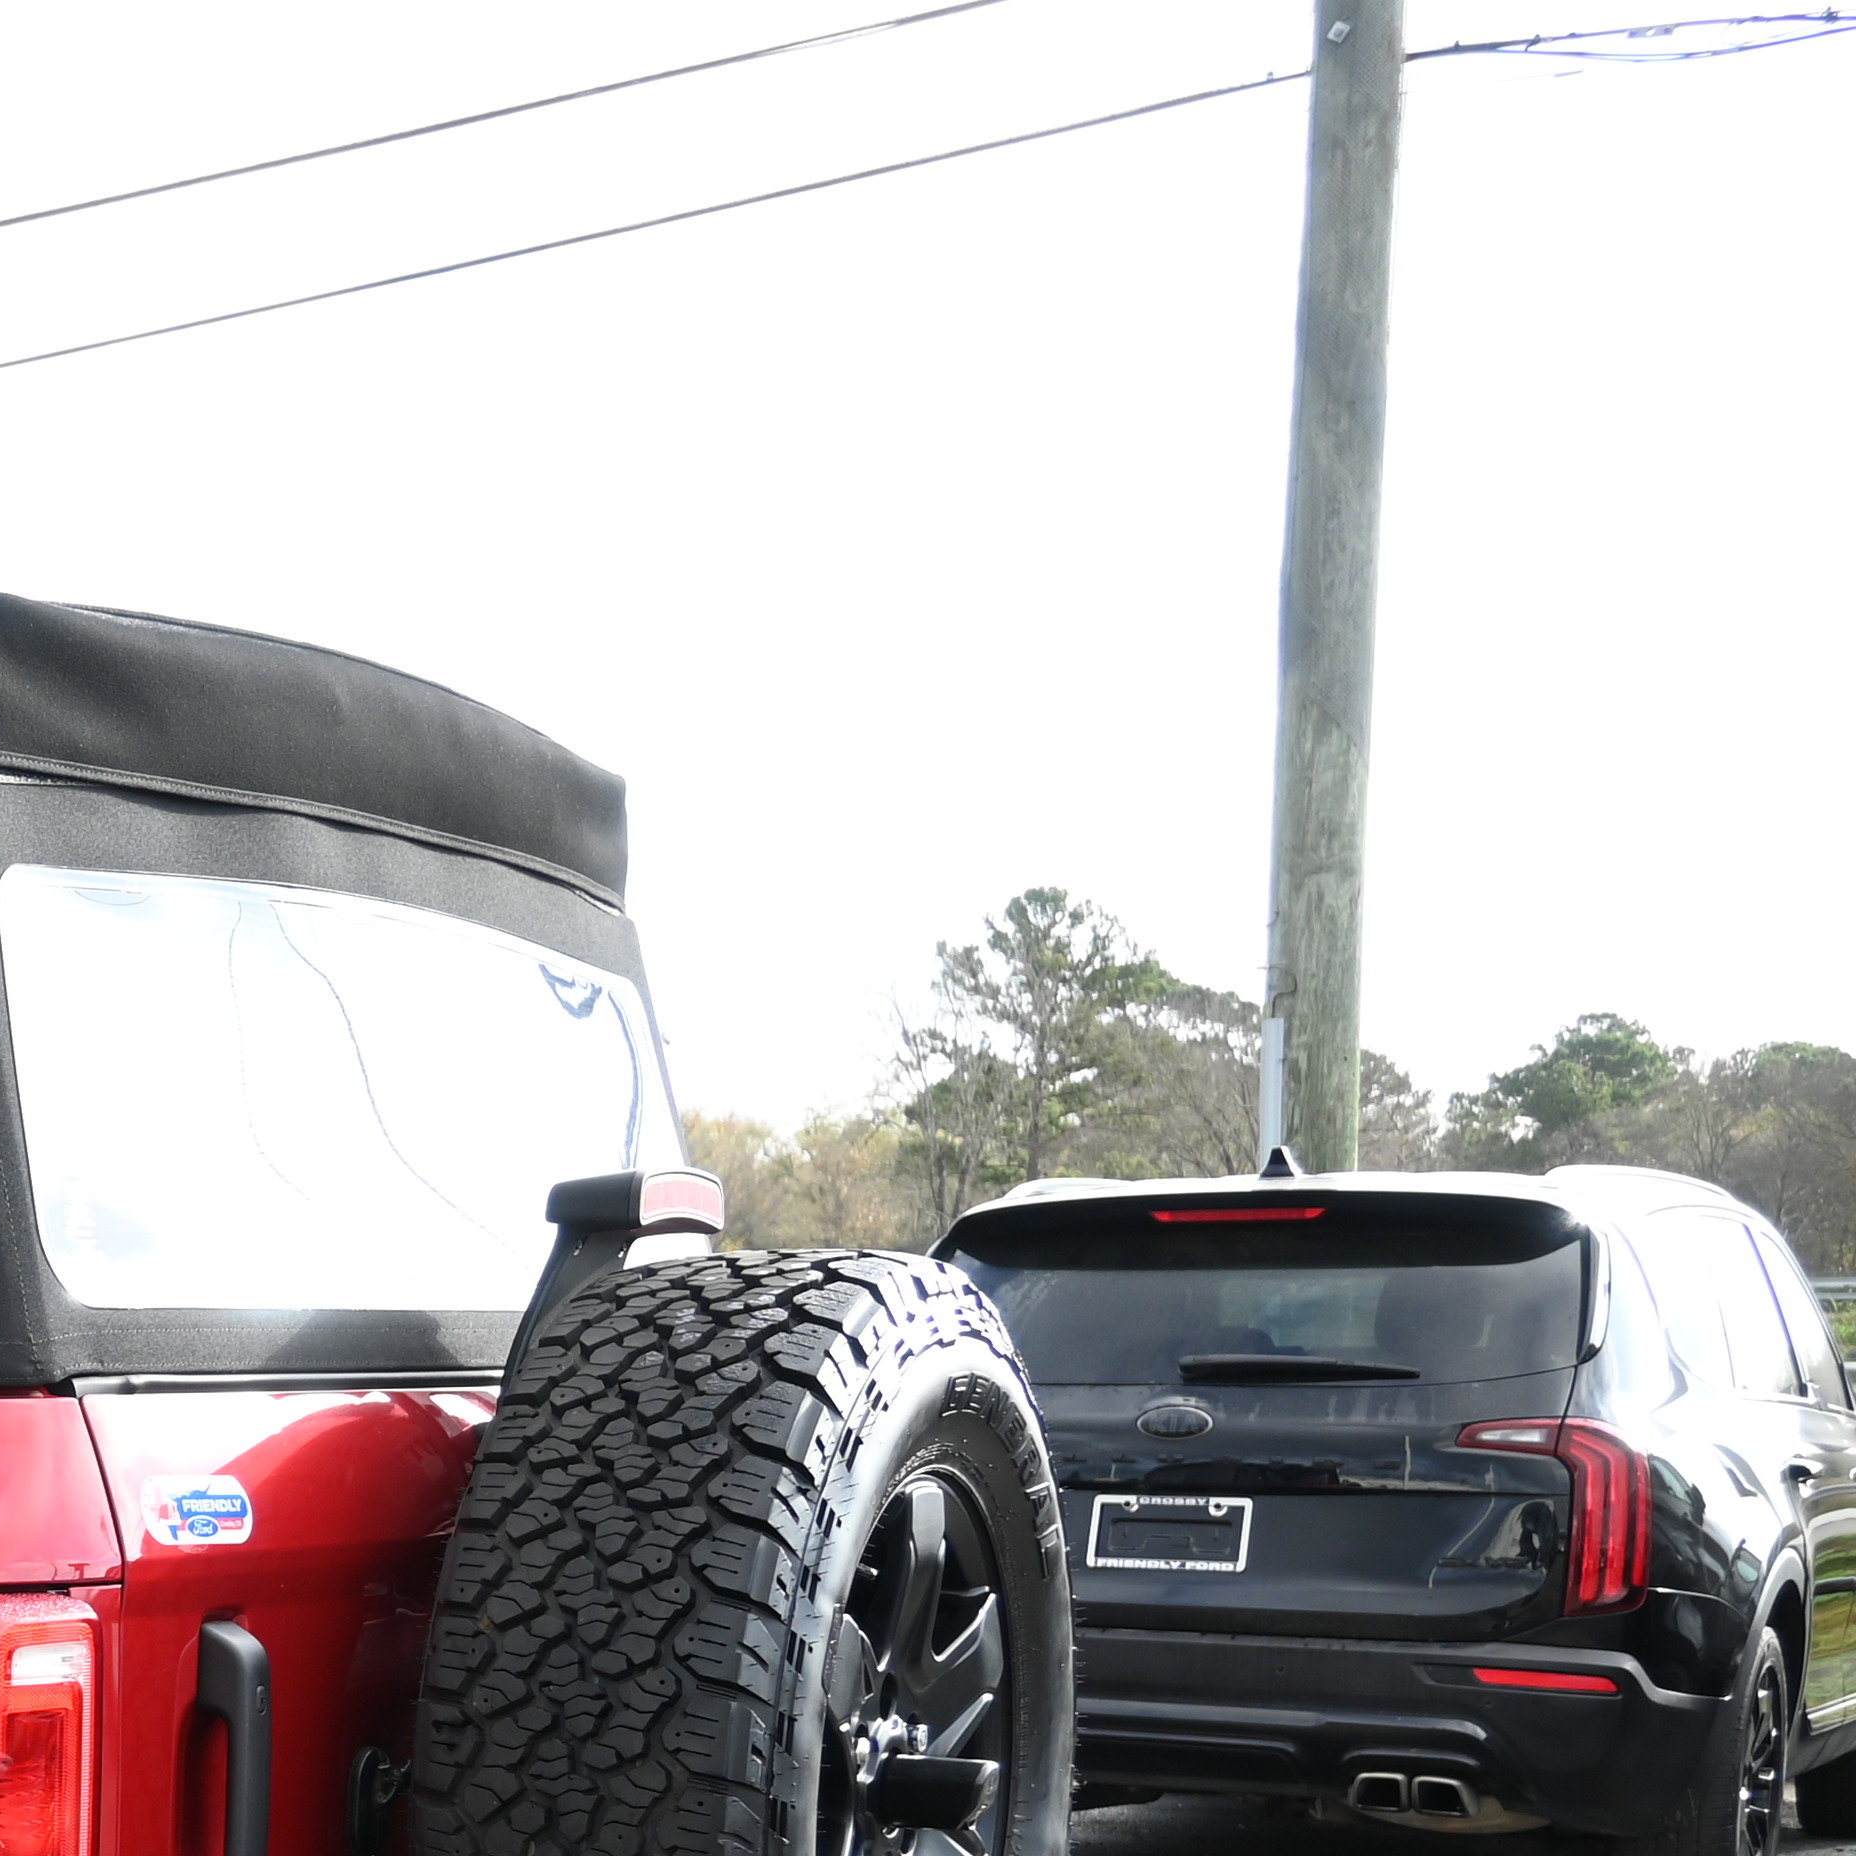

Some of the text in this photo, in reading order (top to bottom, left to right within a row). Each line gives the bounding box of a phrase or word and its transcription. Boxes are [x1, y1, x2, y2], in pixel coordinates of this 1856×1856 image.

[940, 1370, 1059, 1582] GENERAL
[181, 1498, 242, 1513] FRIENDLY
[1139, 1496, 1207, 1506] CROSBY
[1096, 1558, 1235, 1571] FRIENDLY FORD
